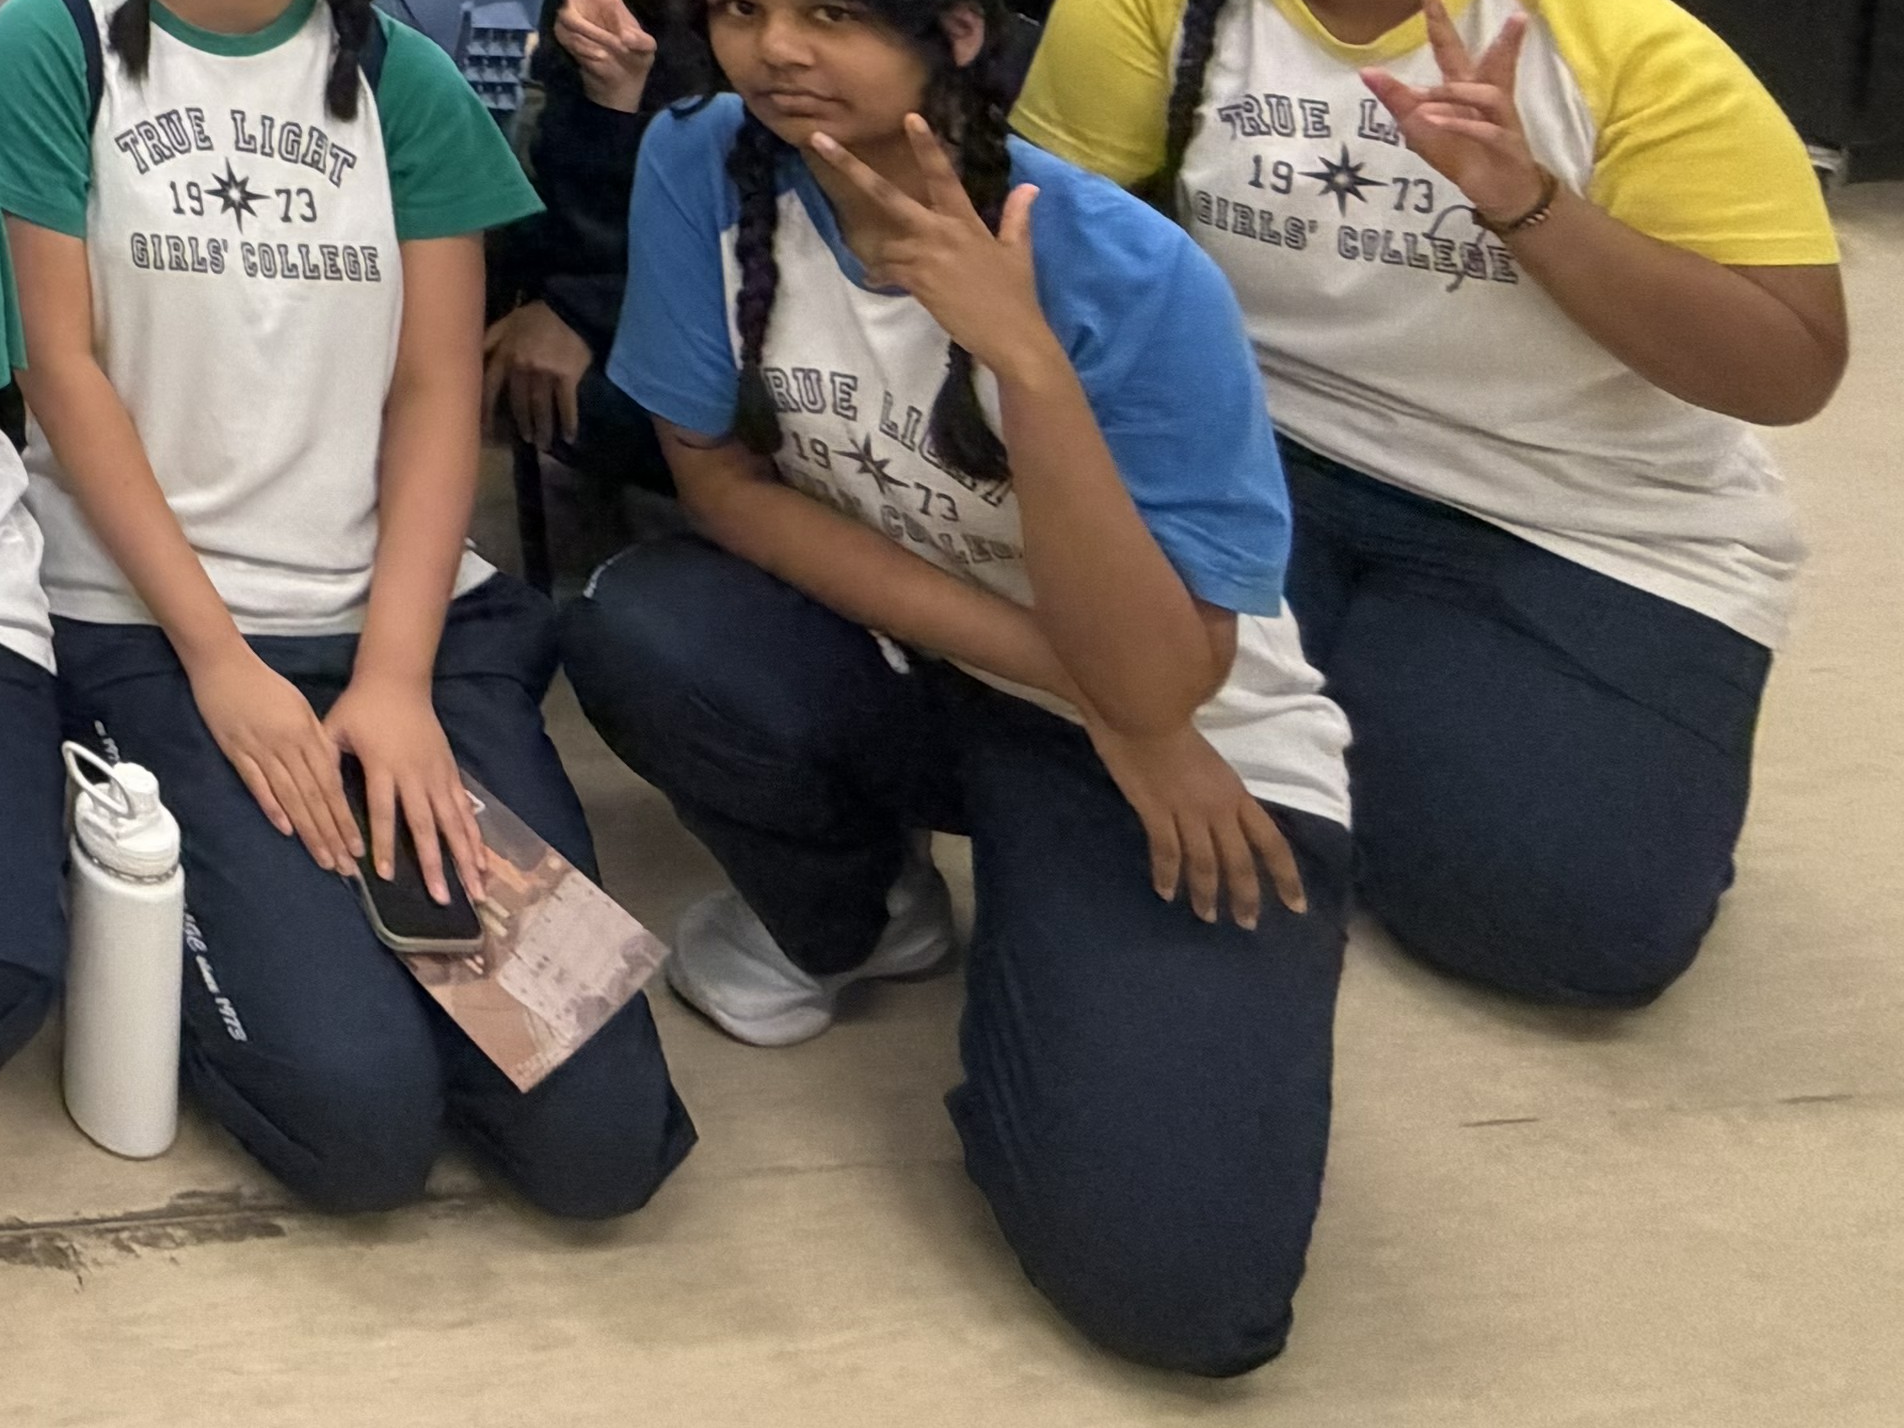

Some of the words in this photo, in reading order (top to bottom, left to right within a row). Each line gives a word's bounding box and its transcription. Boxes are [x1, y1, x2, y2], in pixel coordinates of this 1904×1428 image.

[113, 105, 213, 177] TRUE
[230, 107, 359, 189] LIGHT
[169, 179, 204, 217] 19
[273, 187, 318, 224] 73
[1247, 154, 1295, 195] 19
[1392, 176, 1434, 214] 73
[130, 232, 229, 276] GIRLS'
[241, 240, 382, 282] COLLEGE
[1195, 189, 1318, 251] GIRLS'
[1337, 224, 1519, 286] COLLEGE
[762, 367, 858, 422] RUE
[793, 431, 832, 470] 19
[913, 481, 960, 522] 73
